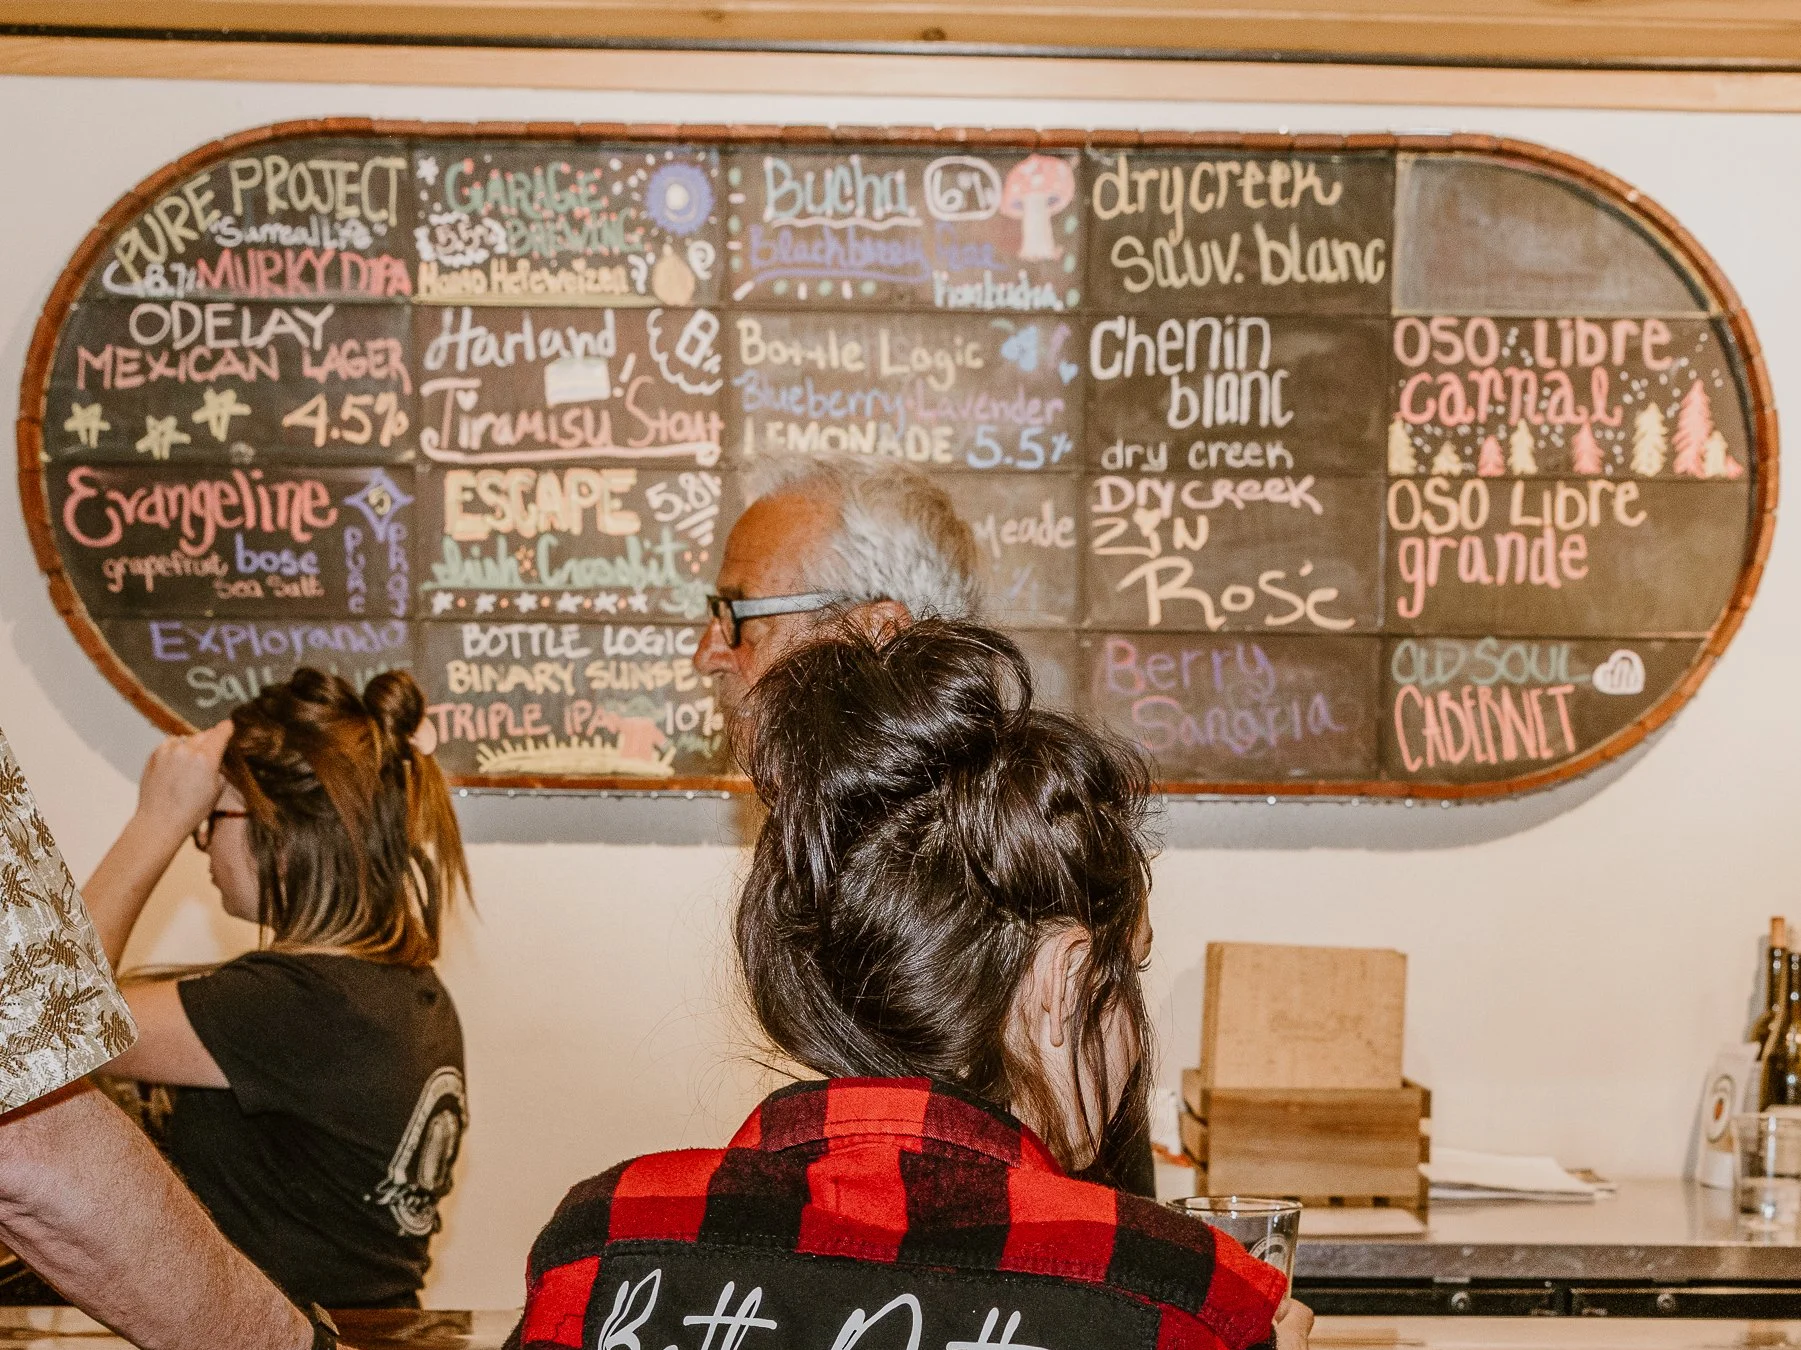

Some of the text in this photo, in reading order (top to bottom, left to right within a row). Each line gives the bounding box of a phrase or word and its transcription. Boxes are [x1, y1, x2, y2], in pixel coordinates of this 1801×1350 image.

[114, 155, 407, 282] PURE PROJECT
[1253, 221, 1387, 286] blanc
[128, 300, 335, 350] ODELAY
[423, 307, 616, 371] Harland
[1089, 314, 1272, 381] Chenin
[1393, 316, 1499, 368] OSO
[77, 338, 413, 395] MEXICAN LAGER
[879, 327, 985, 392] Logic
[732, 368, 1066, 440] Blueberry Lavender
[1166, 368, 1295, 430] blanc
[966, 423, 1074, 470] 5.5%
[1101, 439, 1168, 472] dry
[62, 466, 339, 556] Evangeline
[444, 467, 642, 541] ESCAPE
[1386, 476, 1491, 535] OSO
[1397, 526, 1590, 619] grande
[461, 623, 698, 659] BOTTLE LOGIC
[1104, 637, 1277, 698] Berry
[1391, 636, 1593, 687] OLD SOUL
[446, 659, 577, 695] BINARY
[425, 702, 551, 743] TRIPLE
[563, 699, 620, 736] IPA
